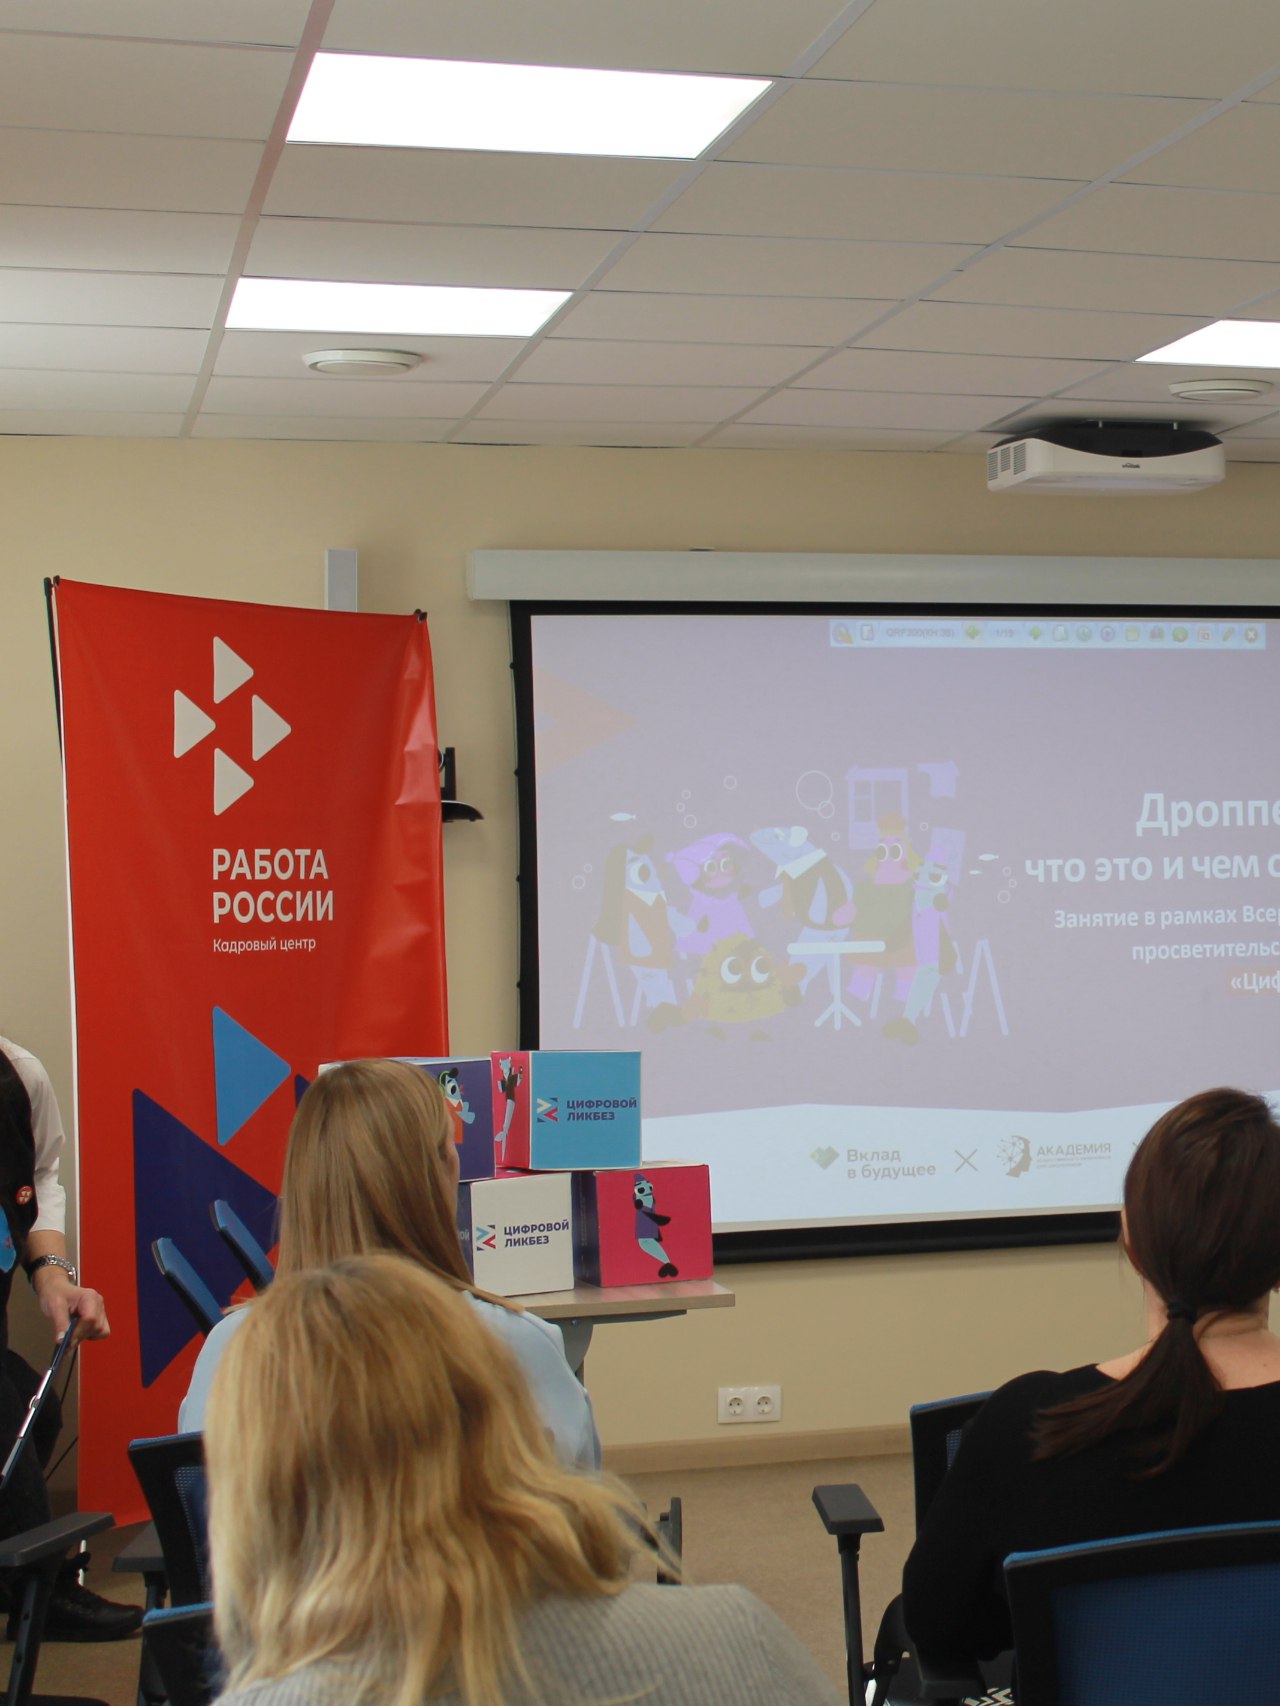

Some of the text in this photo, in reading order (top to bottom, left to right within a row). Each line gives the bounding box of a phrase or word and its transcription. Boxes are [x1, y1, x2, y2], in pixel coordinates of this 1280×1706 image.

[213, 848, 329, 881] РАБОТА
[1025, 858, 1086, 883] что
[1095, 856, 1153, 881] это
[1163, 856, 1184, 880] и
[1191, 854, 1260, 879] чем
[213, 890, 334, 924] РОССИИ
[1054, 910, 1138, 929] Занятие
[1144, 911, 1155, 926] в
[1161, 909, 1238, 930] рамках
[213, 936, 316, 954] Кадровый центр
[566, 1097, 637, 1110] ЦИФРОВОЙ
[567, 1111, 615, 1121] ЛИКБЕЗ
[847, 1149, 901, 1162] Вклад
[1037, 1143, 1111, 1157] АКАДЕМИЯ
[847, 1164, 936, 1181] в будущее
[504, 1219, 569, 1236] ЦИФРОВОЙ
[504, 1235, 549, 1248] ЛИКБЕЗ
